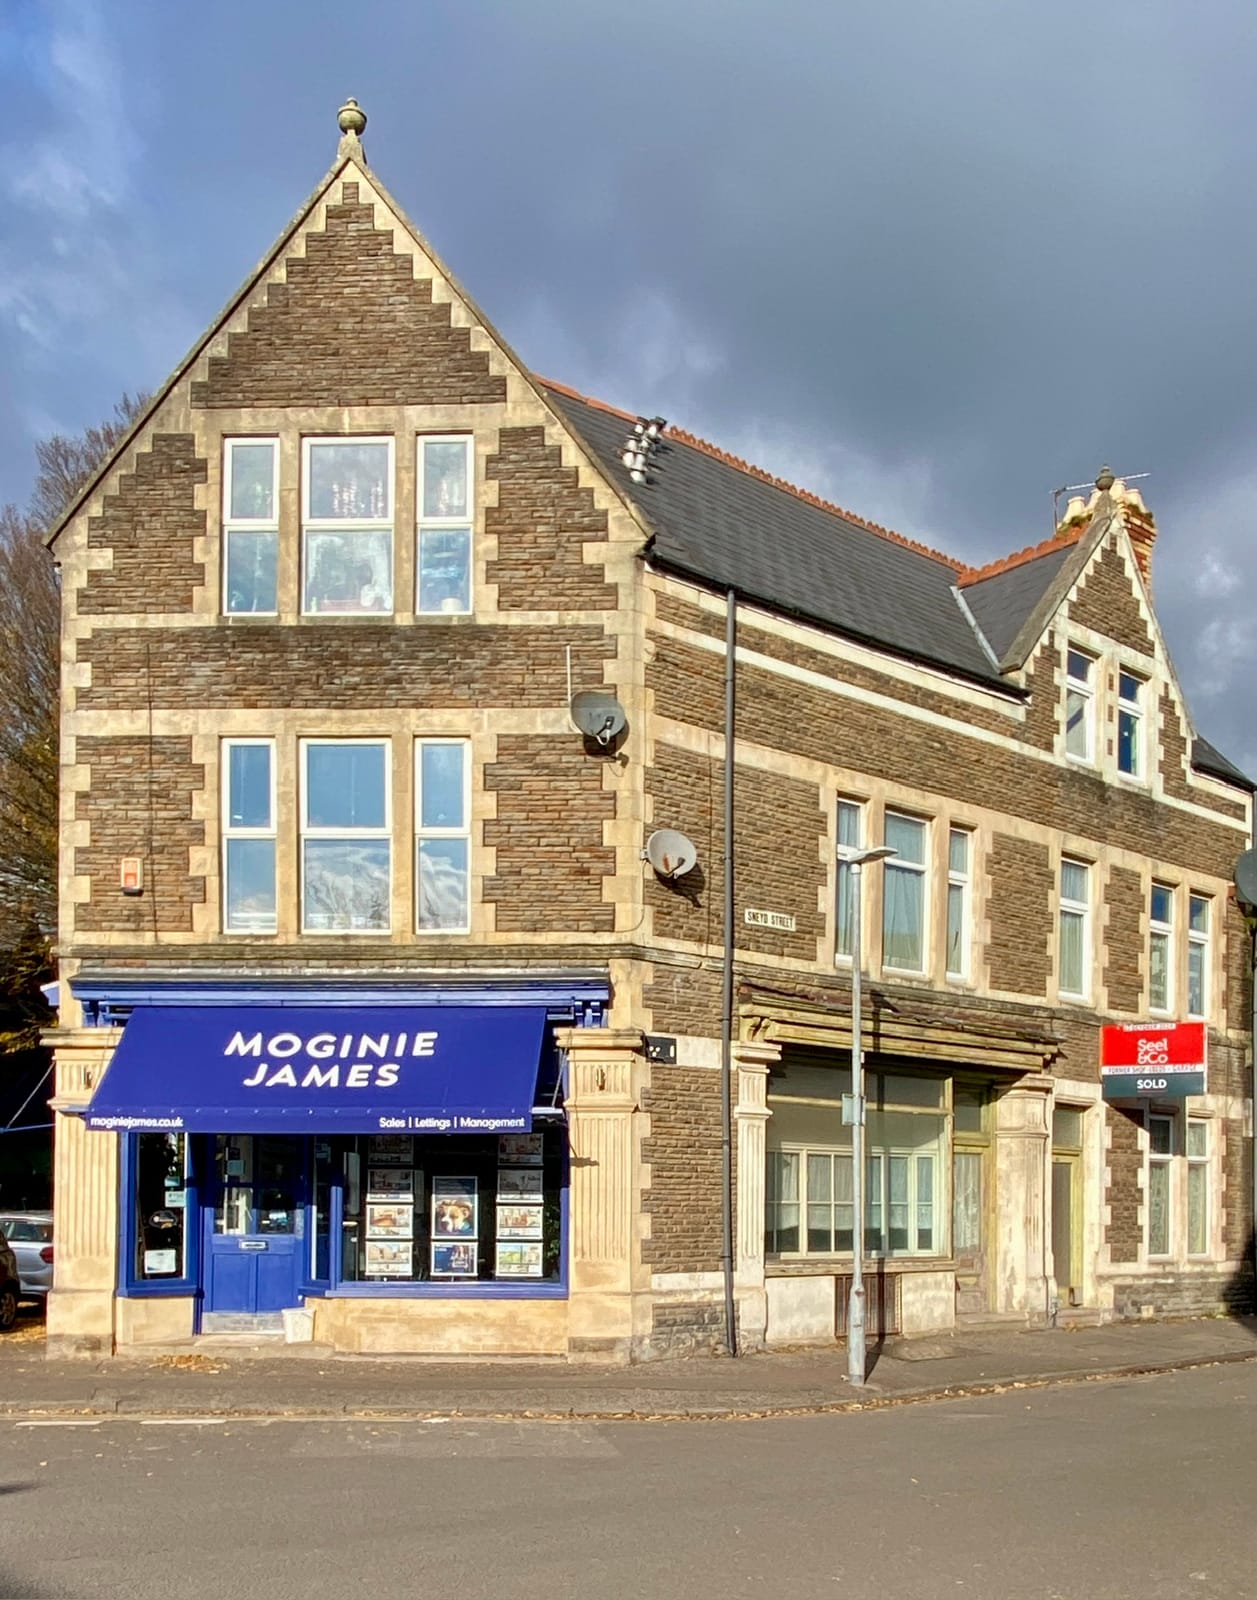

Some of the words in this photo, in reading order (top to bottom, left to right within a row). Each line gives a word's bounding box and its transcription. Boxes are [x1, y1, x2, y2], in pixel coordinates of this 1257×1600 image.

[771, 915, 793, 928] STREET
[224, 1031, 438, 1058] MOGINIE
[1137, 1038, 1168, 1051] Seel
[1137, 1052, 1168, 1064] &Co
[243, 1063, 400, 1088] JAMES
[1137, 1079, 1167, 1089] SOLD
[90, 1116, 184, 1129] moginiejames.co.uk
[379, 1117, 406, 1128] Sales
[415, 1117, 451, 1130] Lettings
[460, 1117, 525, 1130] Management
